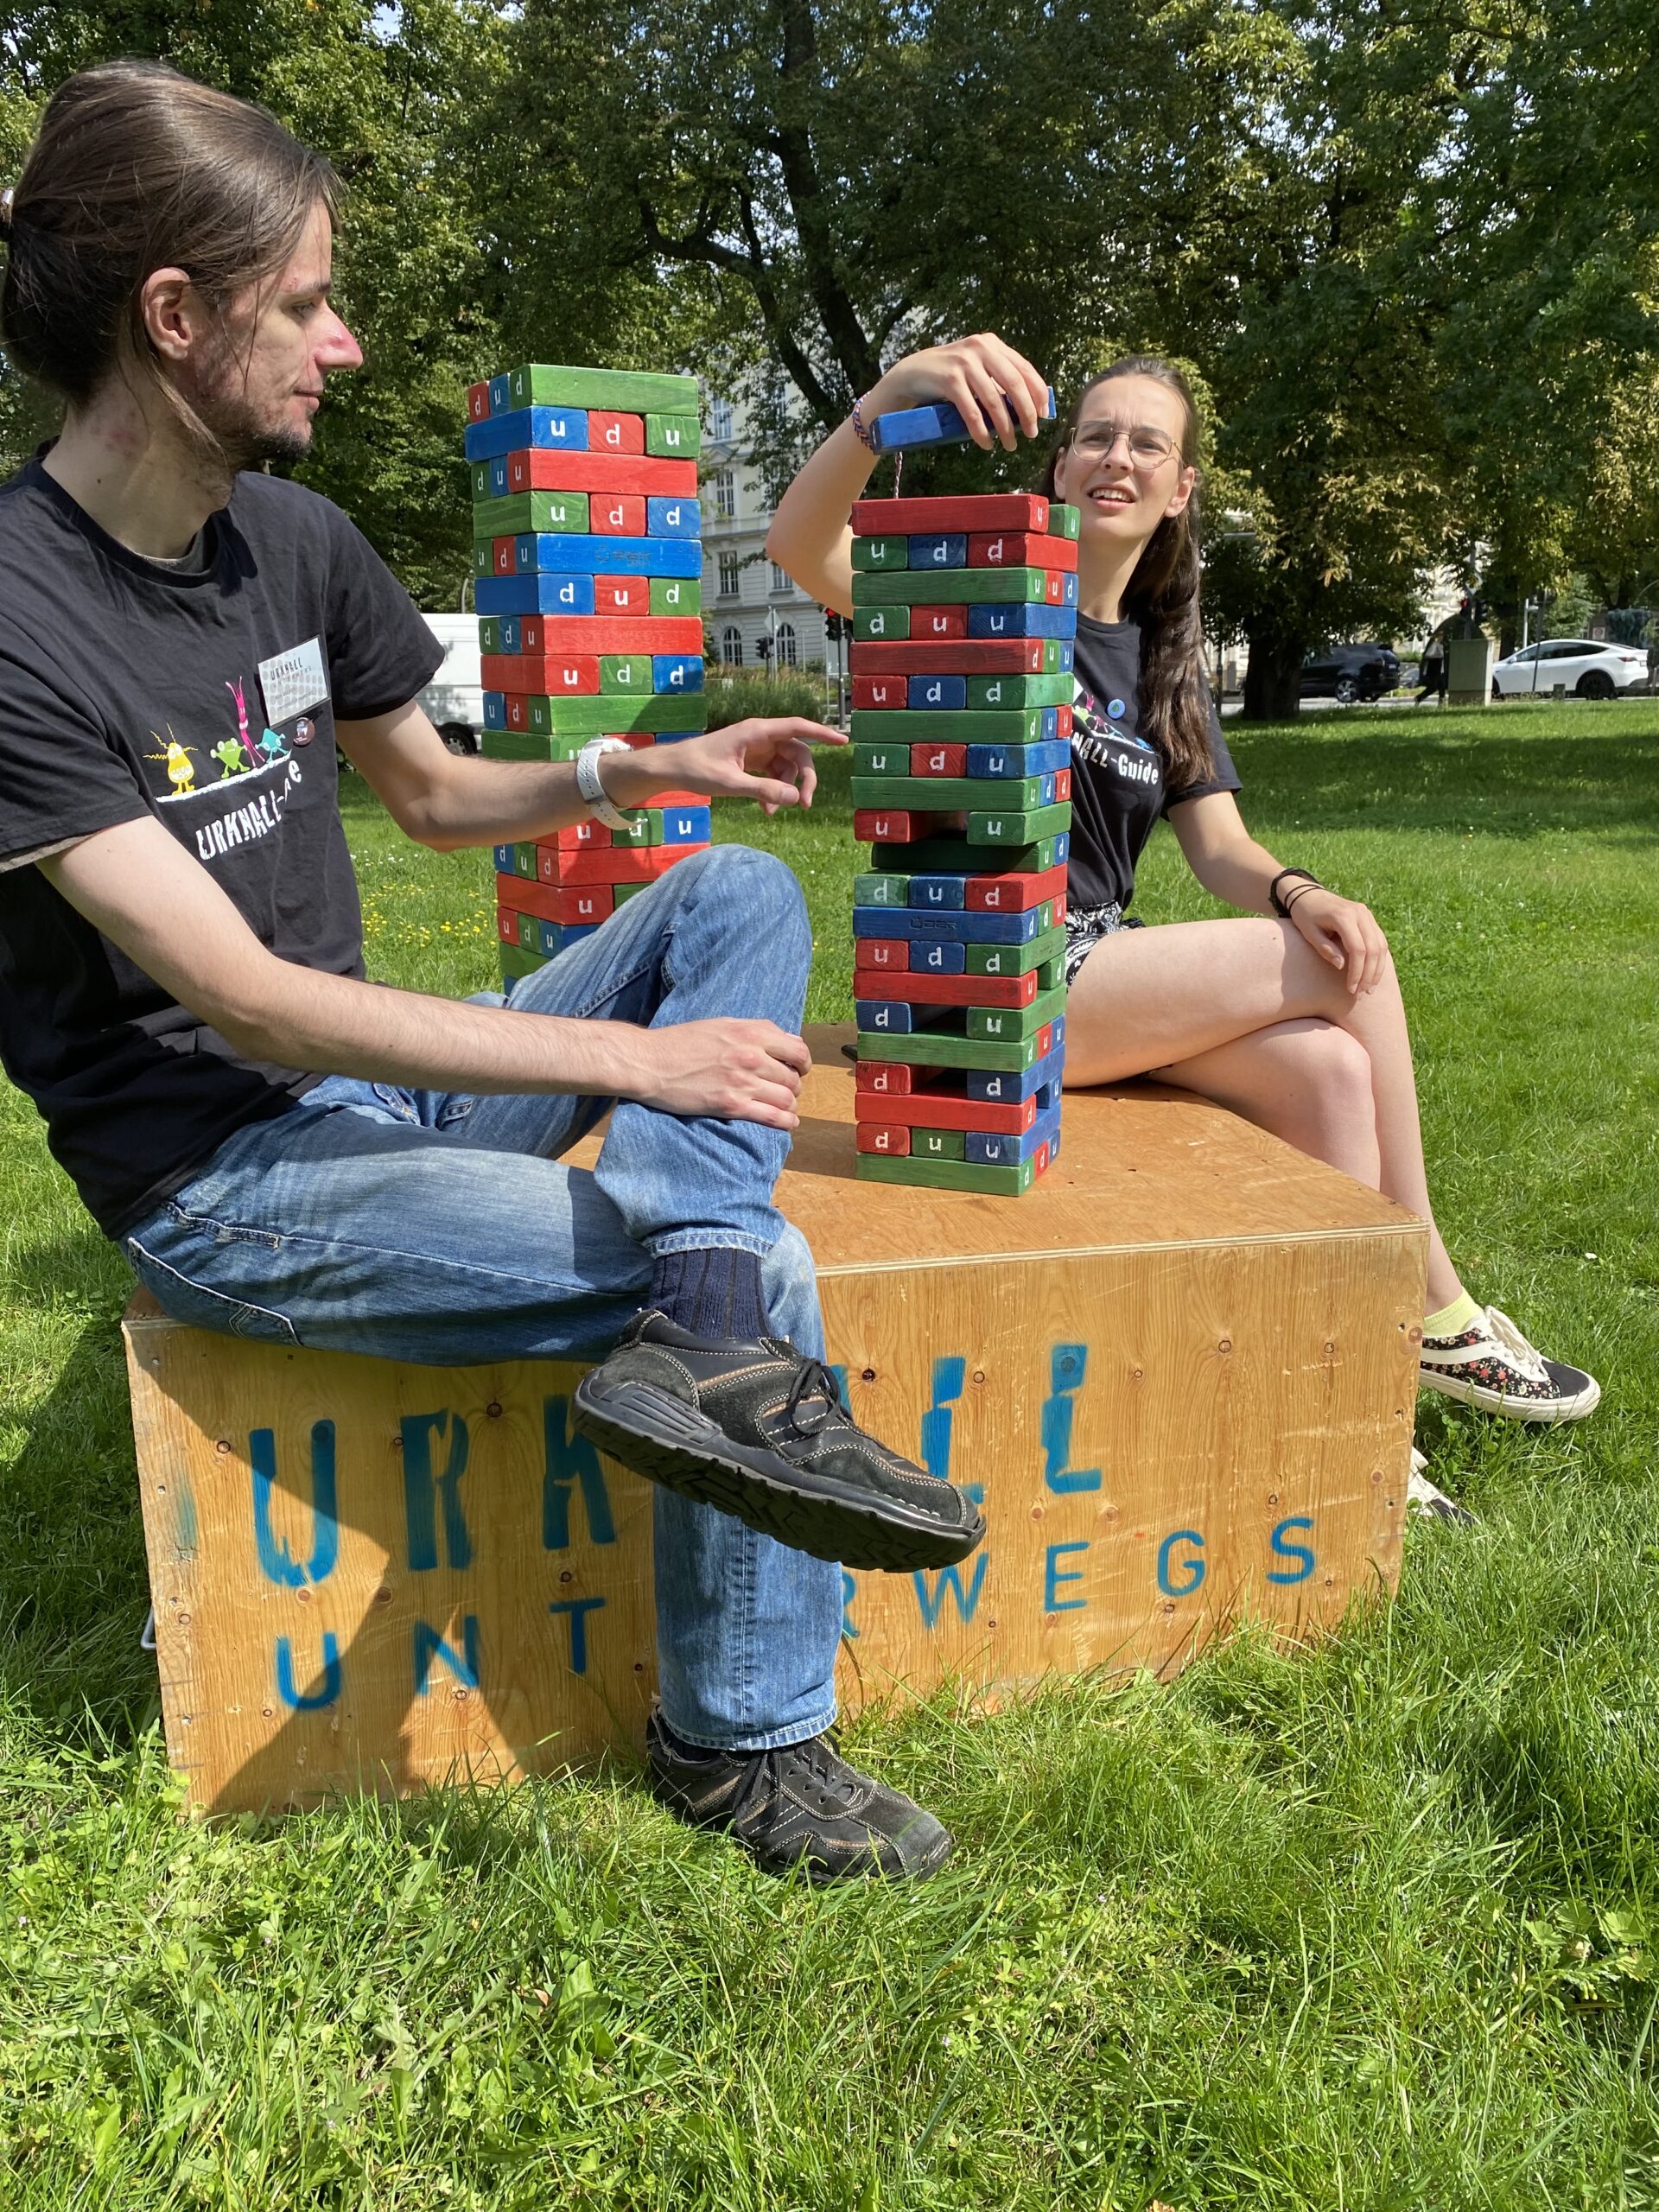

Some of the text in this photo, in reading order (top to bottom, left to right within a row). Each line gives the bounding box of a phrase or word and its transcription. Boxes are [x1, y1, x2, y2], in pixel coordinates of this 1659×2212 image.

[475, 373, 522, 416] d u d
[550, 420, 679, 446] u d u
[478, 466, 521, 491] d u u
[550, 505, 680, 525] u d d
[479, 548, 528, 568] u d u
[871, 538, 1002, 563] u d d
[560, 582, 679, 606] d u d
[1035, 579, 1072, 599] u u d
[485, 625, 535, 645] d d u
[869, 613, 1004, 633] d u u
[1033, 646, 1070, 668] d u u
[563, 664, 683, 685] u d d
[873, 682, 1001, 702] u d d
[489, 703, 542, 724] u d u
[1030, 715, 1068, 738] d u u
[872, 751, 1004, 772] u d u
[1071, 732, 1159, 785] NALL-Guide
[1030, 777, 1066, 803] u d d
[576, 825, 590, 839] u
[678, 821, 691, 835] u
[875, 821, 1001, 836] u u
[499, 845, 551, 875] d u d
[1045, 838, 1064, 864] u d
[874, 879, 1000, 906] d u d
[579, 899, 593, 913] u
[1029, 904, 1062, 936] d d u
[503, 920, 553, 949] u d u
[874, 947, 1000, 972] u d d
[1028, 963, 1061, 995] u d
[875, 1008, 1001, 1033] d u
[1028, 1028, 1061, 1063] d u u
[874, 1072, 1001, 1096] d d
[1027, 1105, 1033, 1124] d
[875, 1132, 998, 1159] d u u
[1025, 1143, 1057, 1186] d d u
[249, 1343, 1103, 1588] URKLL
[275, 1517, 1317, 1710] UNTWEGS
